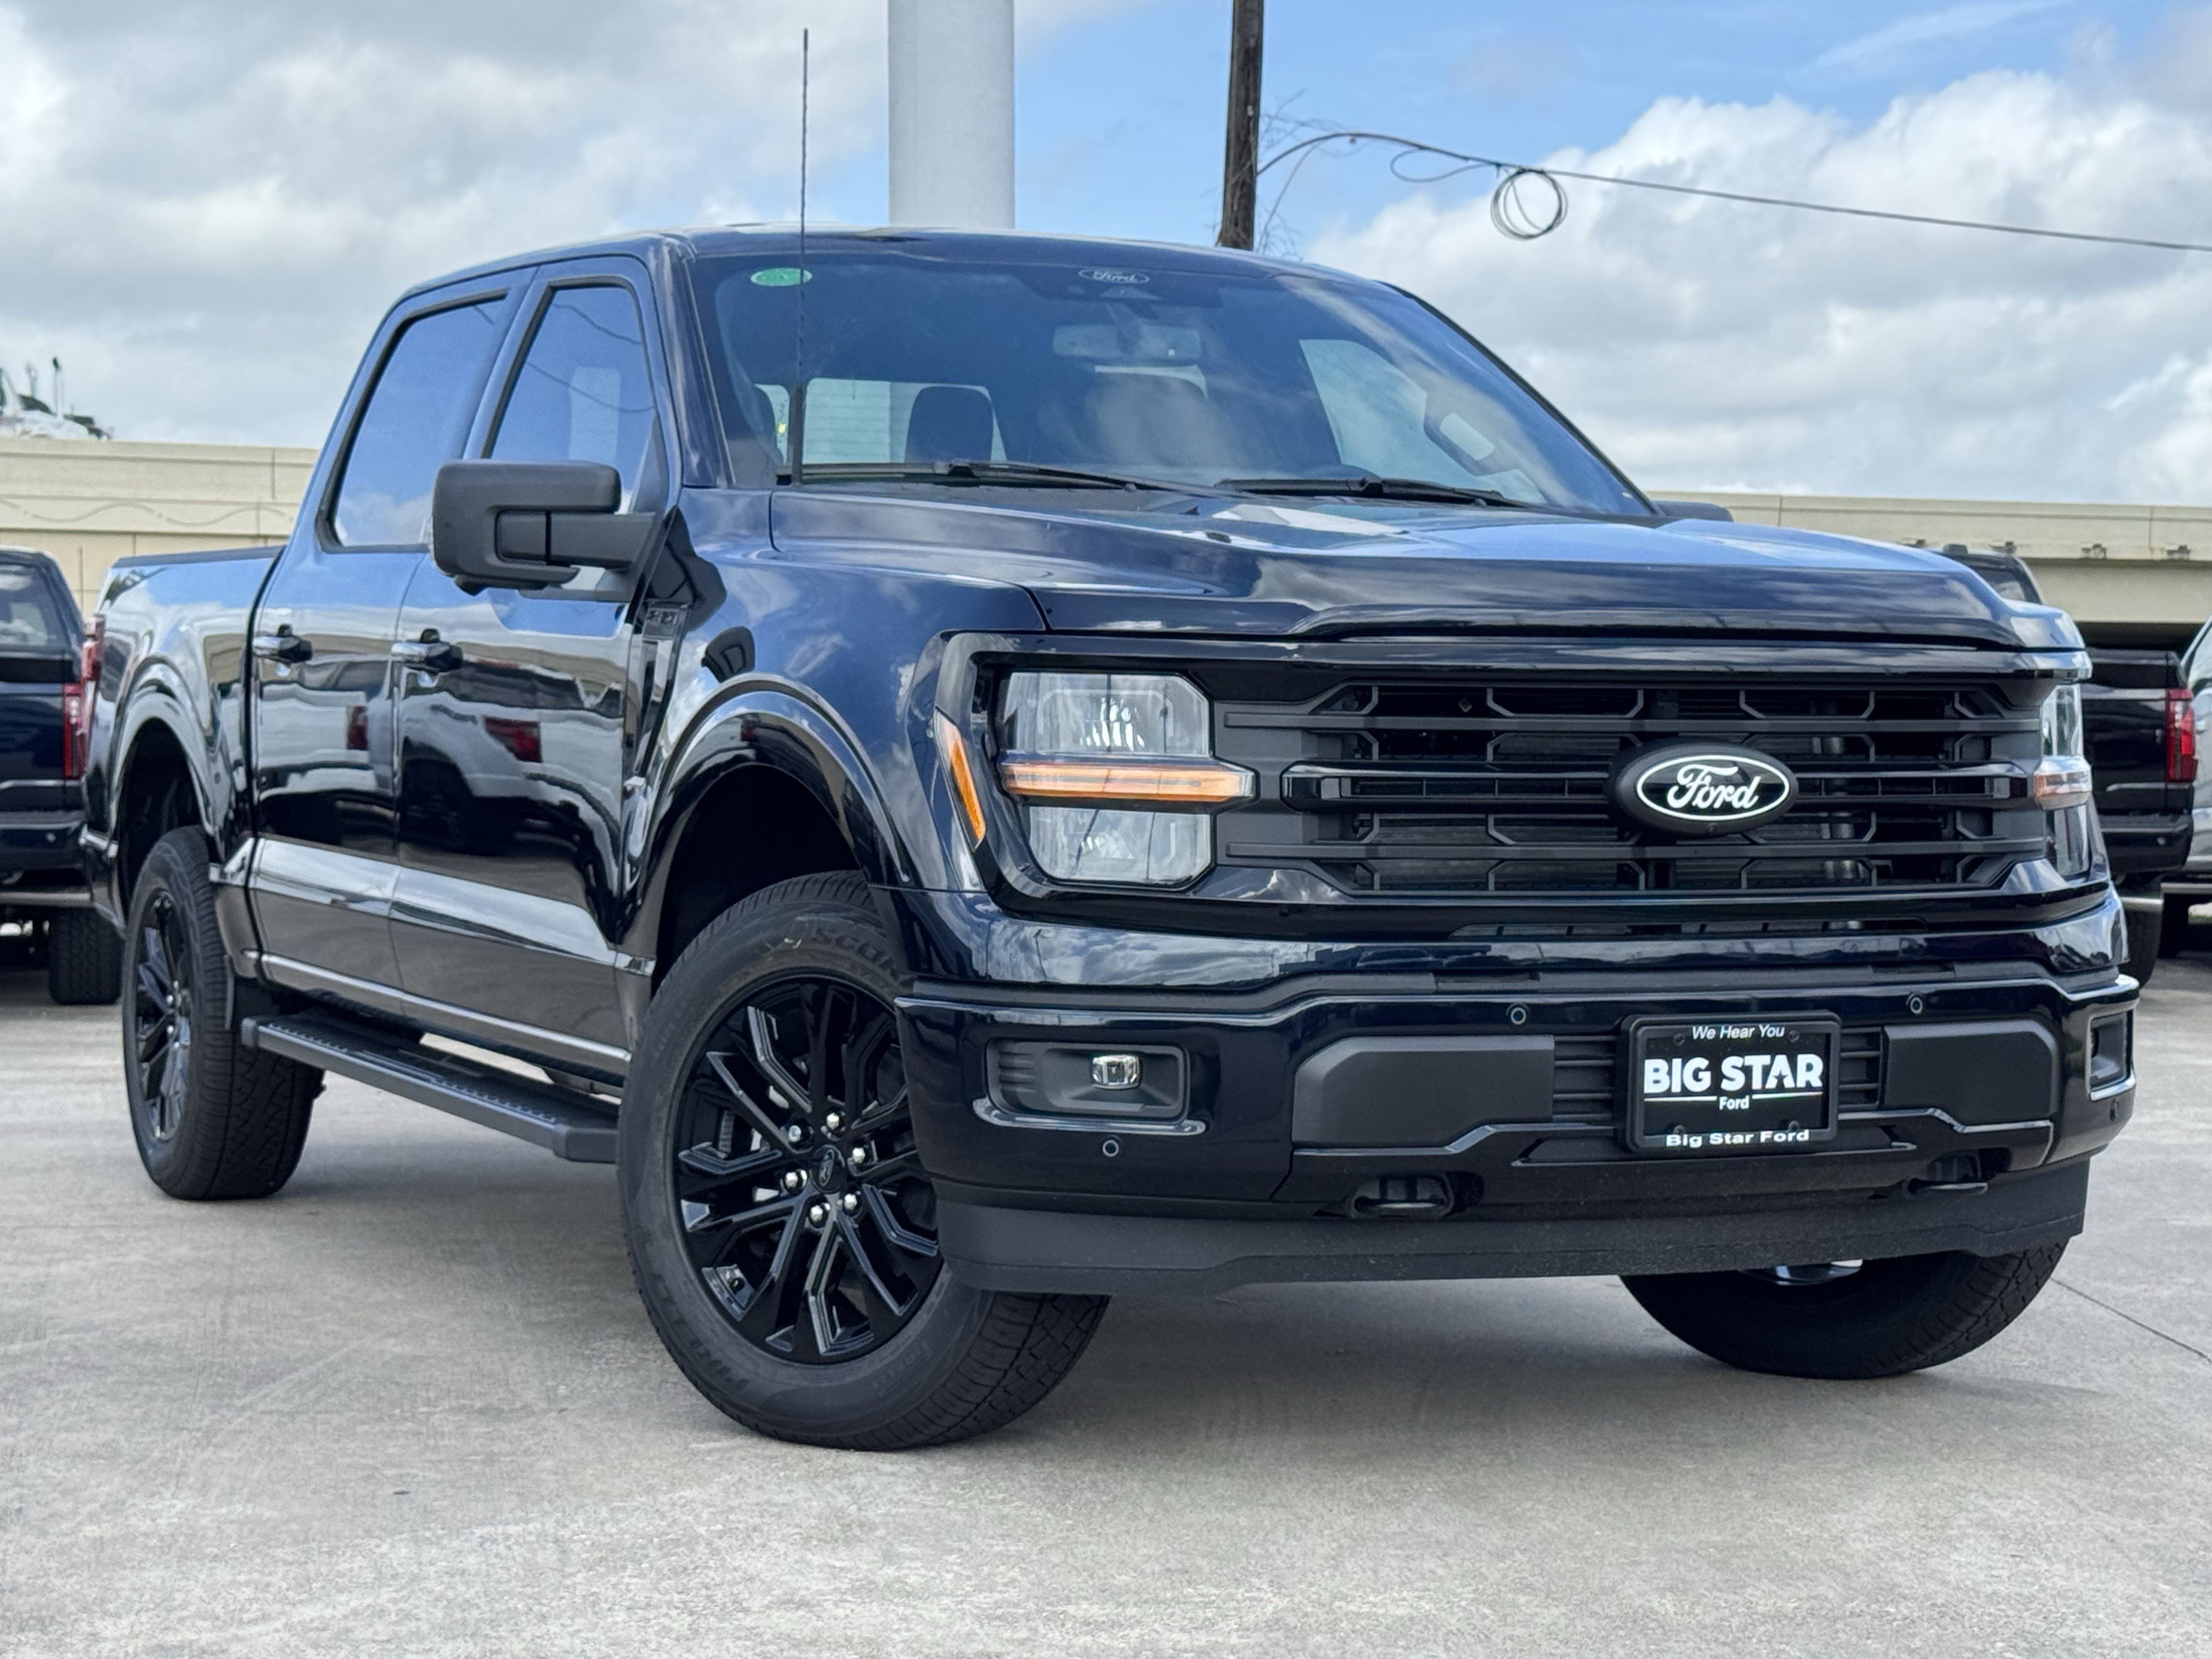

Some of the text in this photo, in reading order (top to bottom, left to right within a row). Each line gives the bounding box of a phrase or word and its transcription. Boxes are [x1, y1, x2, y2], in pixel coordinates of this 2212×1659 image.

[1667, 763, 1761, 809] Ford
[1692, 1023, 1785, 1040] We Hear You
[1644, 1053, 1824, 1094] BIG STAR
[1718, 1096, 1750, 1110] Ford
[1666, 1128, 1810, 1149] Big Star Ford
